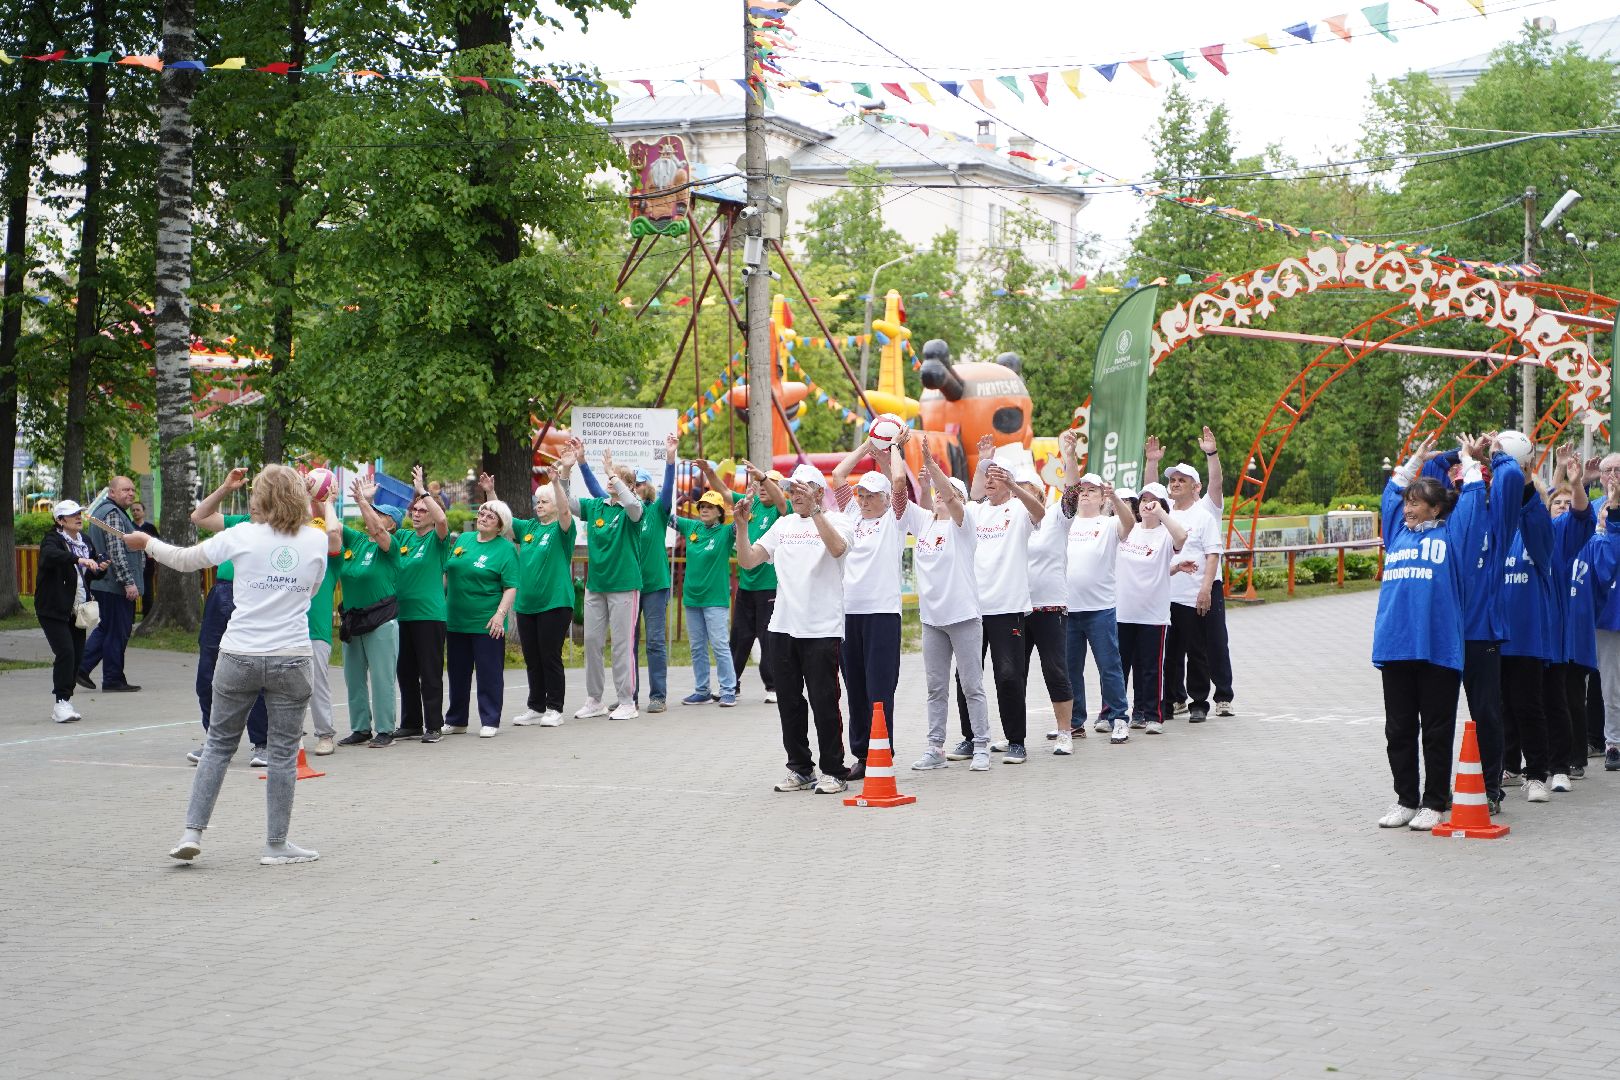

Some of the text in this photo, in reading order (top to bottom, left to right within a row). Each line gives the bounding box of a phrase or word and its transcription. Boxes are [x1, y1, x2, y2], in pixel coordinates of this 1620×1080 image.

[582, 412, 642, 420] ВСЕРОССИЙСКОЕ
[582, 421, 633, 429] ГОЛОСОВАНИЕ
[612, 430, 649, 438] ОБЪЕКТОВ
[598, 438, 665, 447] БЛАГОУСТРОЙСТВА
[1420, 537, 1447, 564] 10
[266, 575, 297, 584] ПАРКИ
